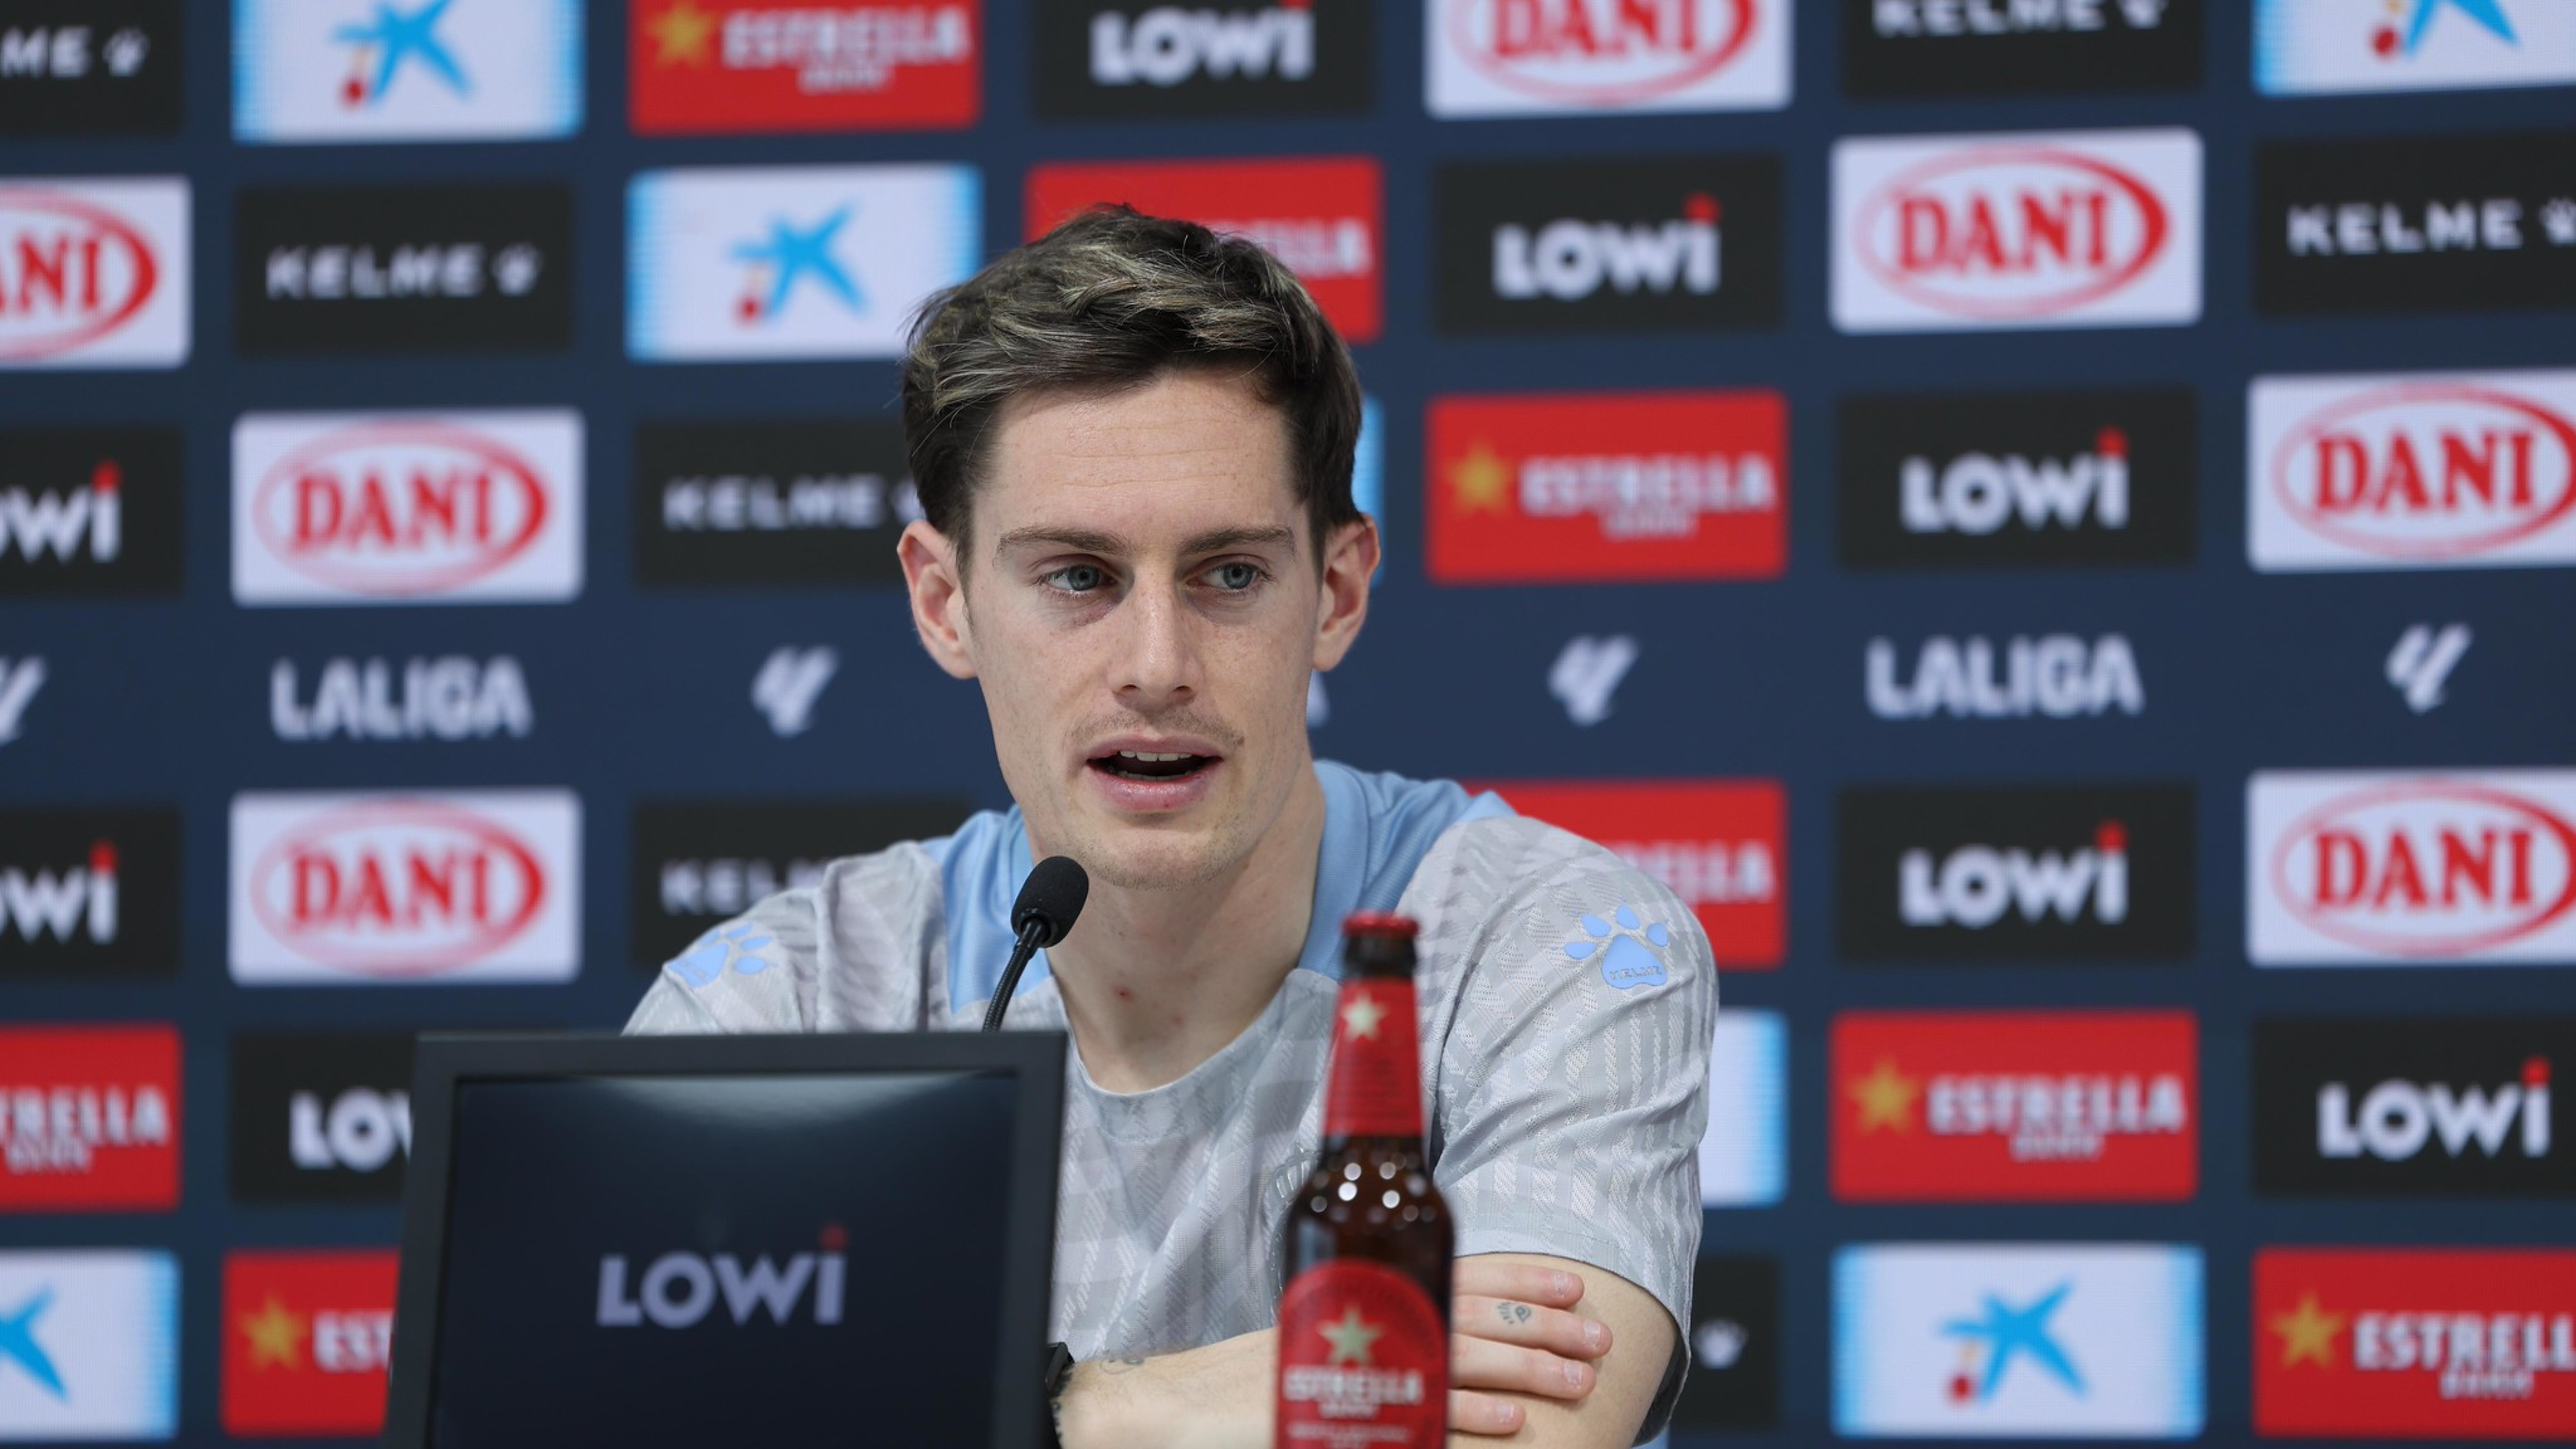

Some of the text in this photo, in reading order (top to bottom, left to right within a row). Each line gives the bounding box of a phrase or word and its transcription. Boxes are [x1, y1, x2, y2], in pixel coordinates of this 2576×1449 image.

[721, 6, 971, 68] ESTRELLA
[1493, 0, 1699, 58] DANI
[1872, 0, 2104, 36] KELME
[1894, 186, 2109, 276] DANI
[2286, 199, 2521, 255] KELME
[0, 233, 101, 311] NI
[266, 244, 482, 299] KELME
[663, 474, 881, 530] KELME
[1518, 453, 1776, 517] ESTRELLA
[2314, 427, 2537, 513] DANI
[288, 468, 493, 555] DANI
[270, 655, 533, 740] LALIGA
[1866, 634, 2144, 718] LALIGA
[286, 843, 491, 932] DANI
[2313, 823, 2536, 909] DANI
[0, 1085, 170, 1146] RELLA
[290, 1088, 412, 1170] LO
[1927, 1074, 2187, 1134] ESTRELLA
